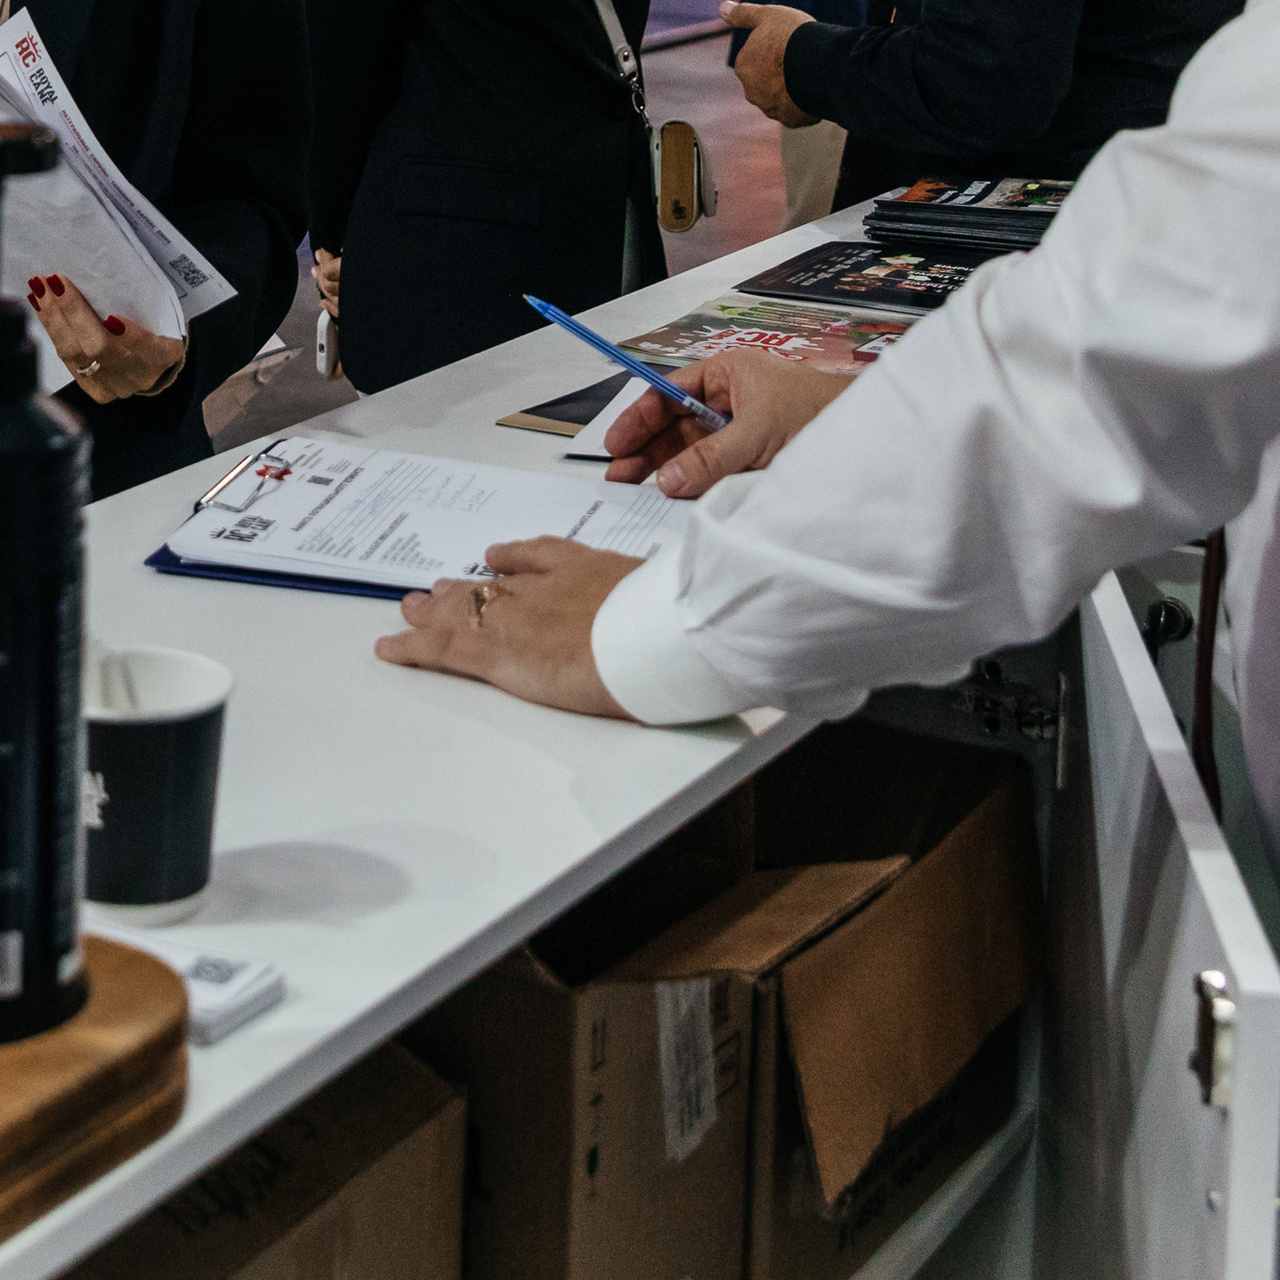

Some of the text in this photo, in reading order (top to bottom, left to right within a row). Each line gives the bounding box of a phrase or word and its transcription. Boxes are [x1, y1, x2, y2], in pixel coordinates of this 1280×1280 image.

[15, 37, 36, 68] RC
[29, 73, 50, 107] CANE
[36, 67, 59, 106] ROYAL
